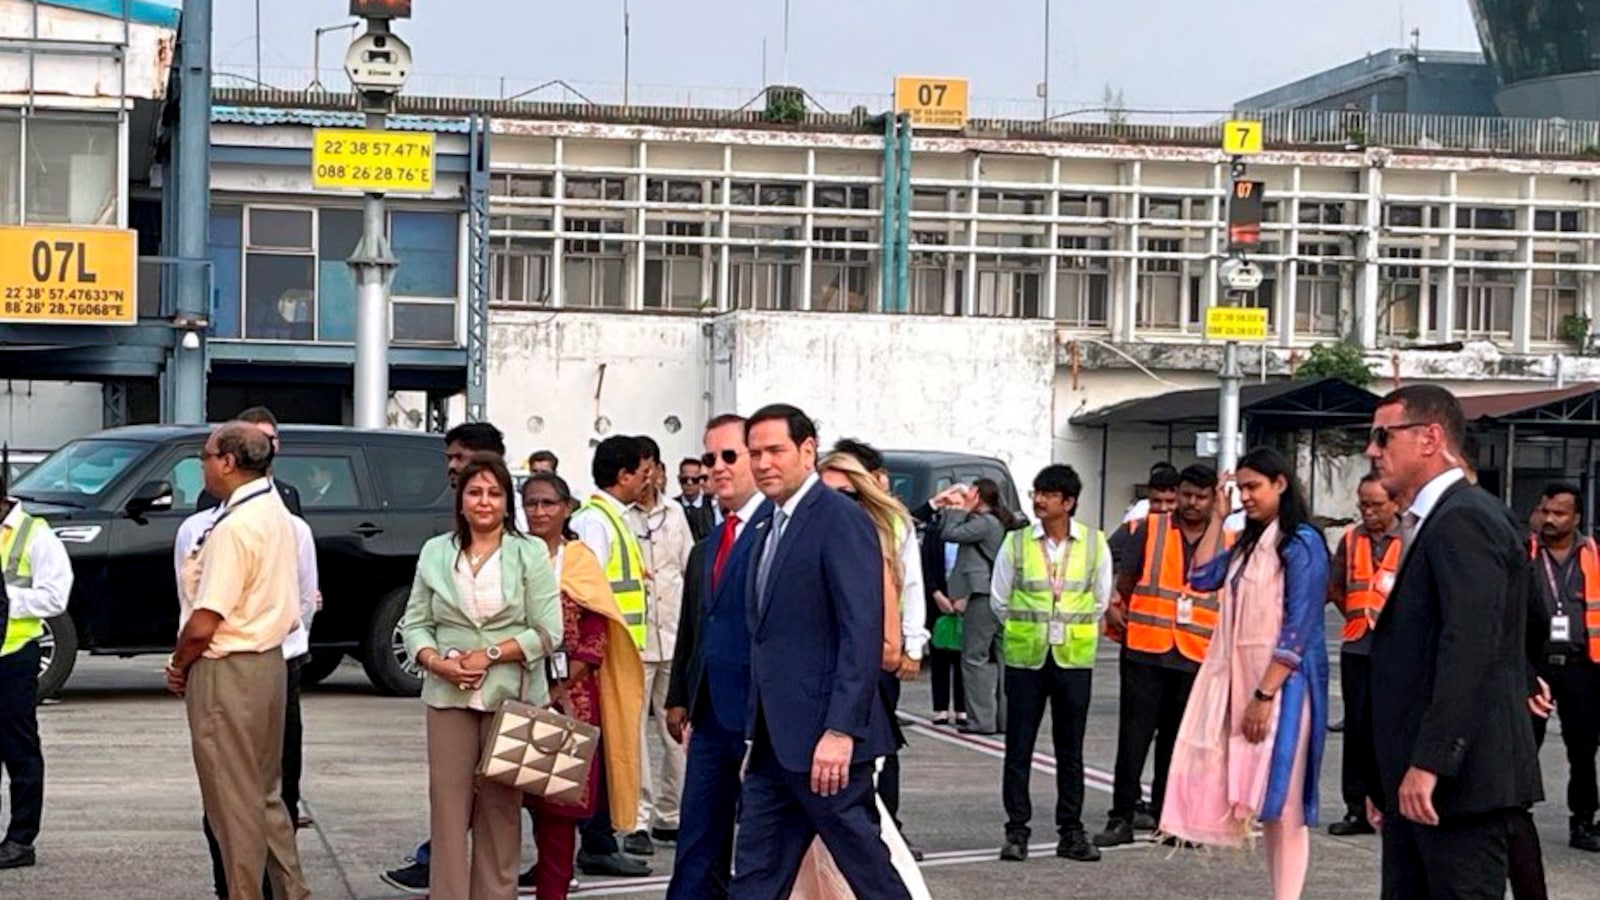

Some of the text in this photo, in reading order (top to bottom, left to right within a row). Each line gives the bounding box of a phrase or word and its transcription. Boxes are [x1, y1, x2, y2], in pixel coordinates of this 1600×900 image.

[918, 84, 947, 107] 07
[1236, 128, 1250, 148] 7
[1237, 182, 1253, 199] 07
[32, 240, 97, 283] 07L
